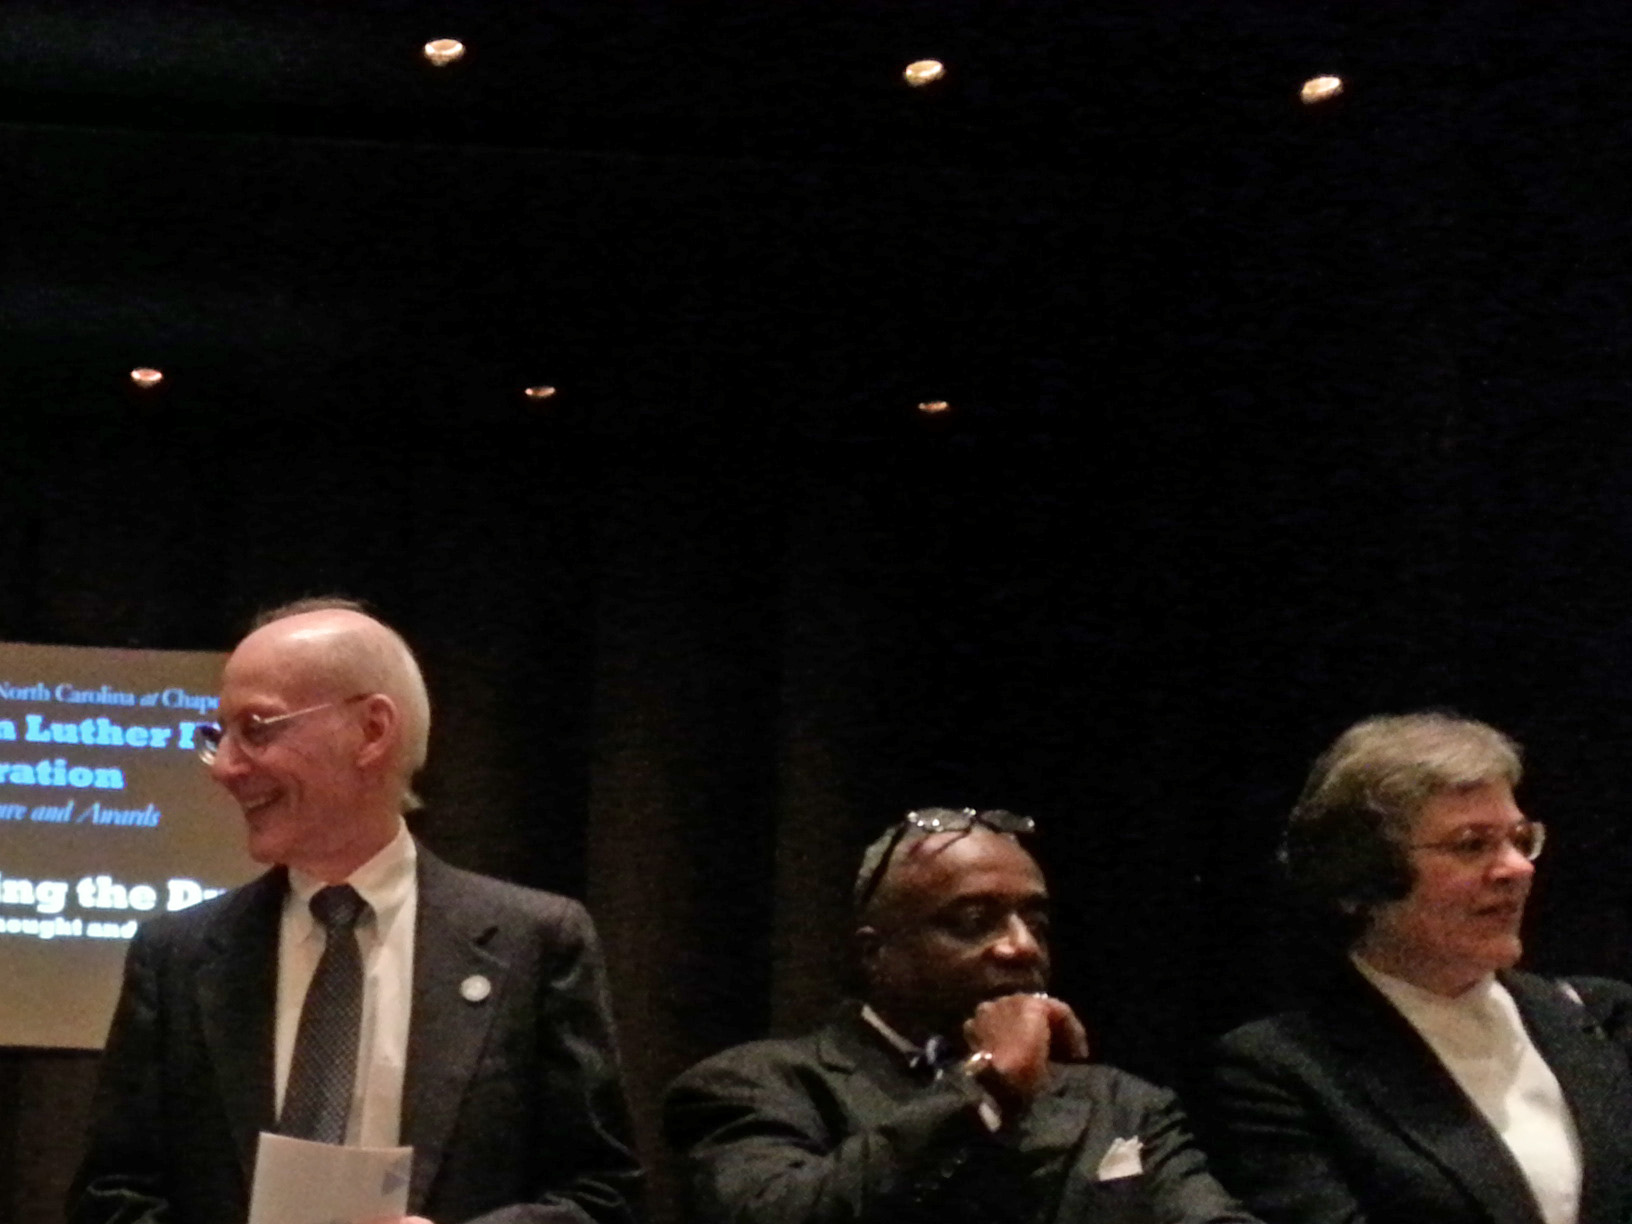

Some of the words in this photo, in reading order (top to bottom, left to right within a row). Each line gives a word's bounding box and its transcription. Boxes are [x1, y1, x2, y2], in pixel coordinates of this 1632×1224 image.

[54, 683, 136, 706] Carolina
[24, 714, 172, 749] Luther
[30, 798, 75, 824] and
[75, 801, 162, 827] Awards
[76, 874, 157, 911] the
